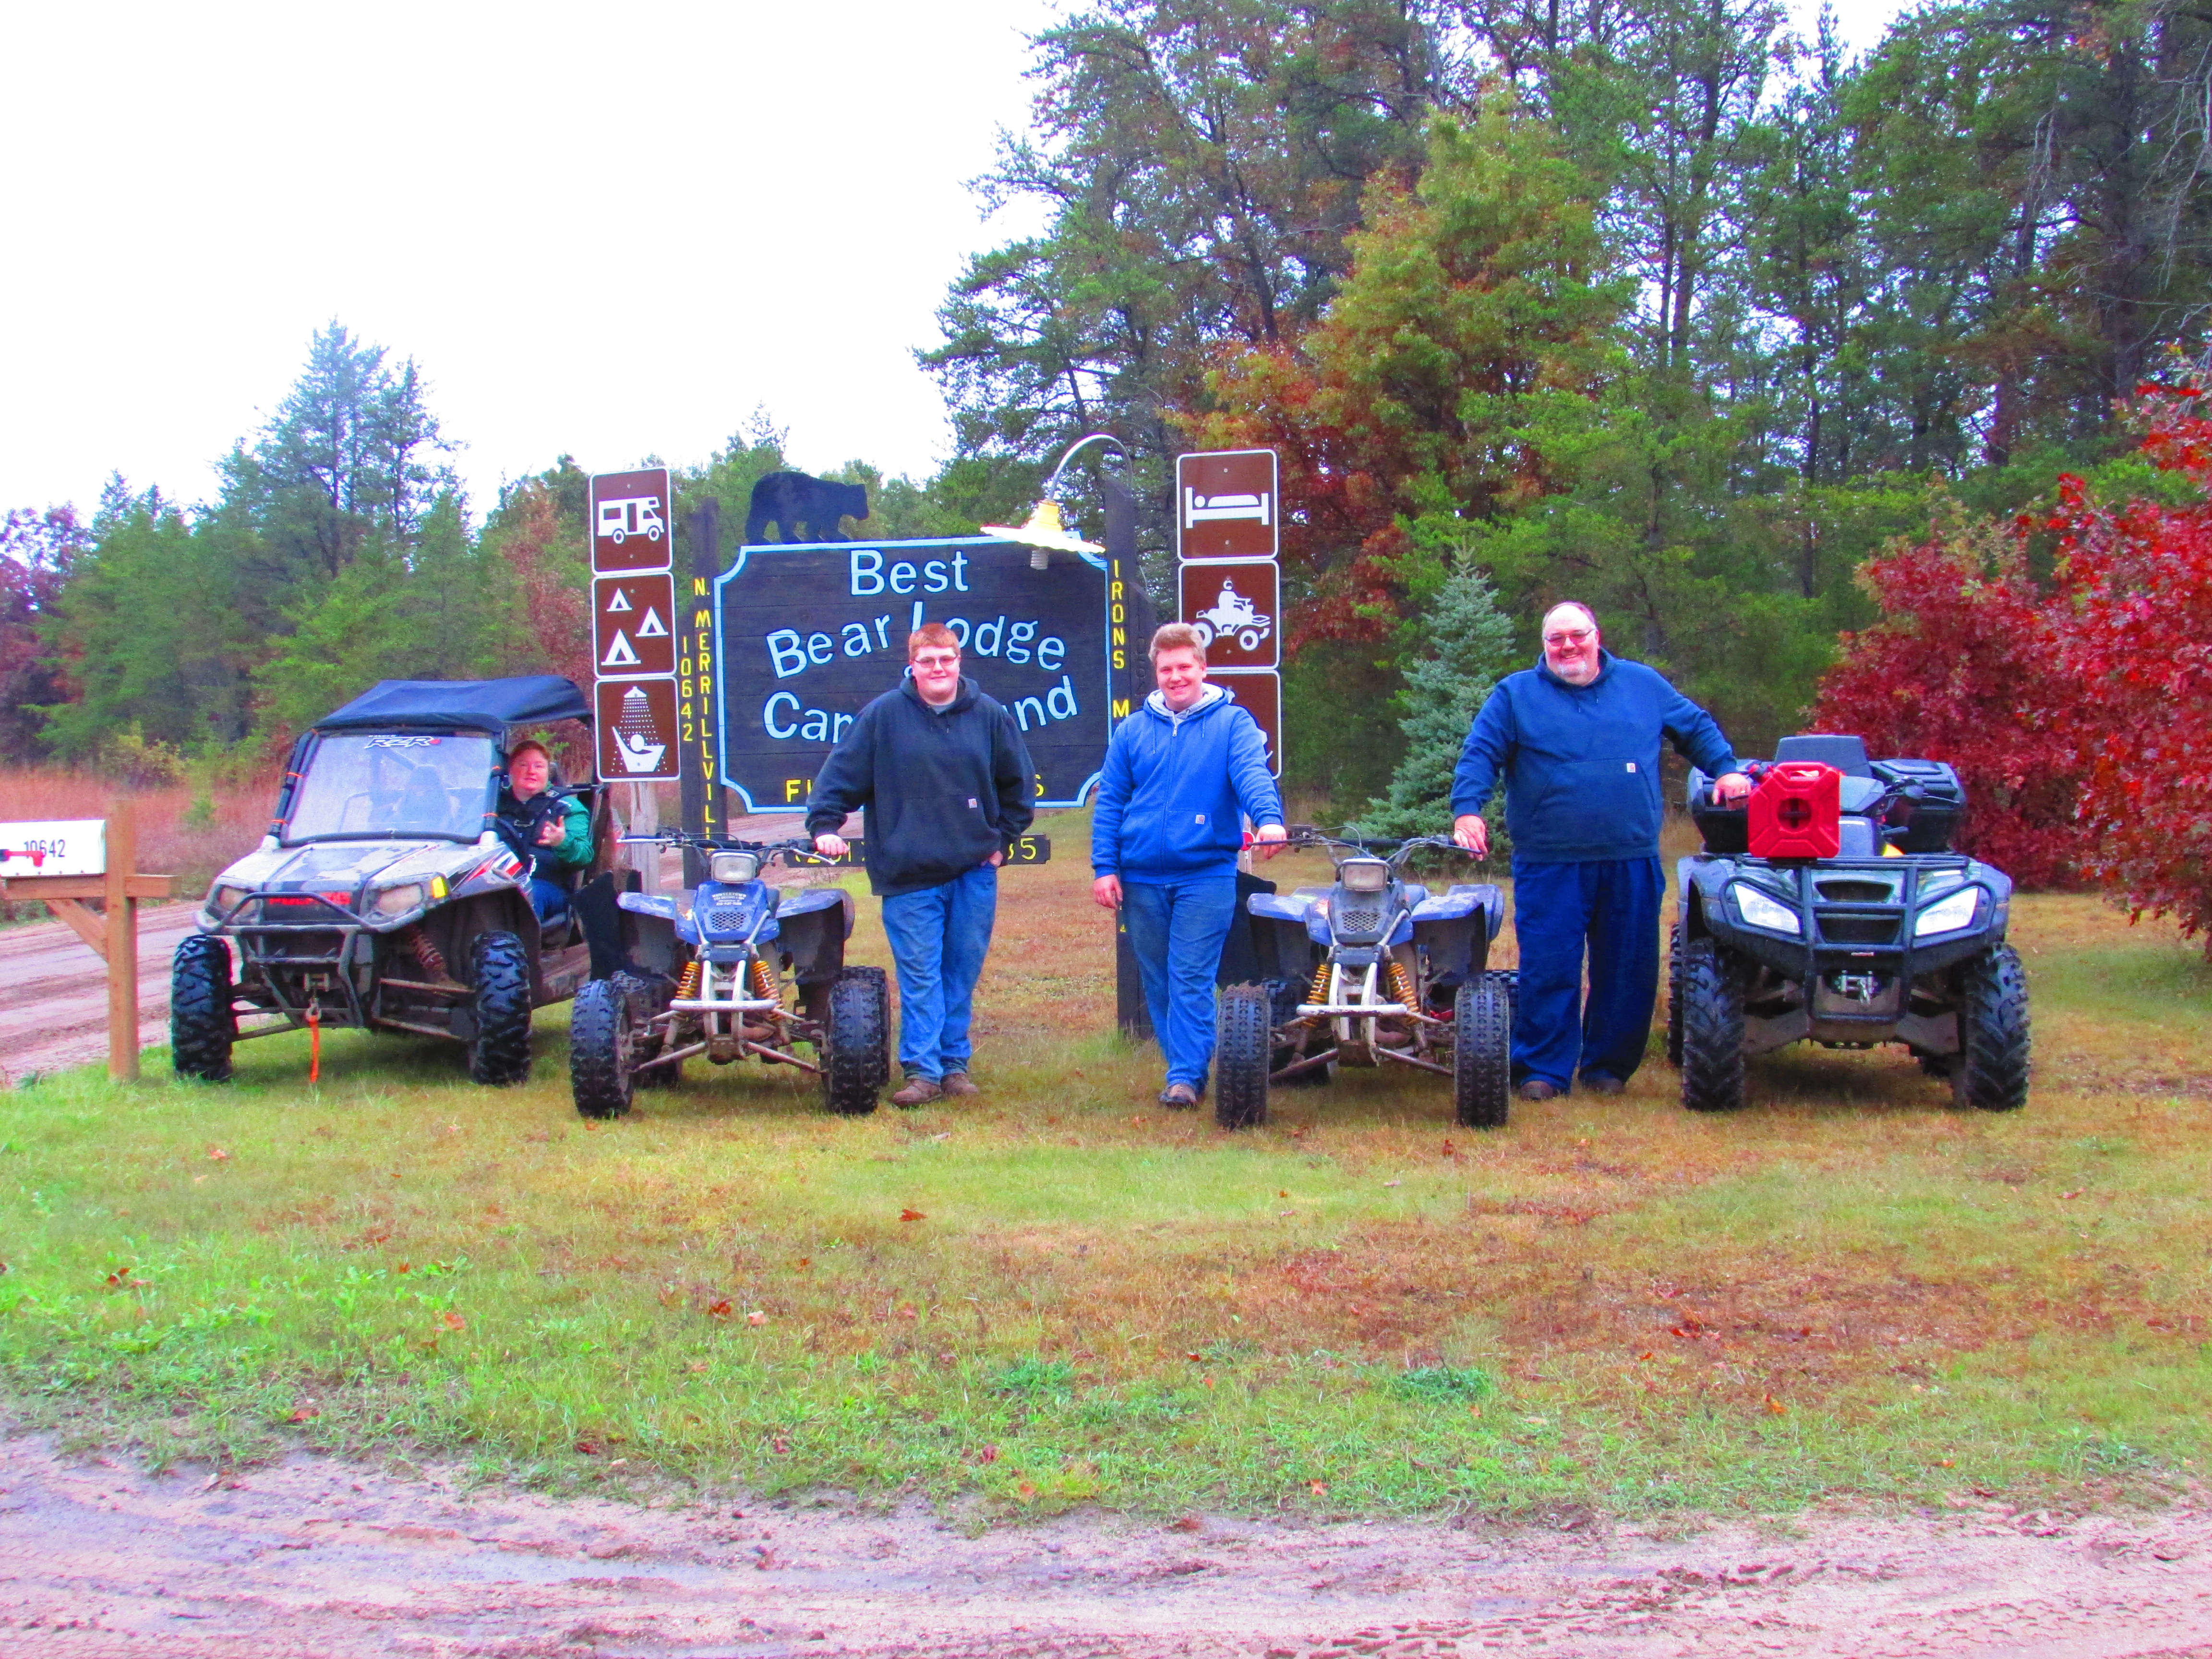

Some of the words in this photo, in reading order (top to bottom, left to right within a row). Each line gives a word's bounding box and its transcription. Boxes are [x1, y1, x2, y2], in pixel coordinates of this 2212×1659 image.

[694, 577, 710, 596] N.
[850, 549, 968, 595] Best
[1111, 559, 1125, 669] IRONS
[766, 614, 890, 679] Bear
[681, 636, 693, 741] 10642
[364, 736, 434, 749] RZR
[695, 609, 716, 856] MERRILLVIL
[24, 839, 66, 858] 10642
